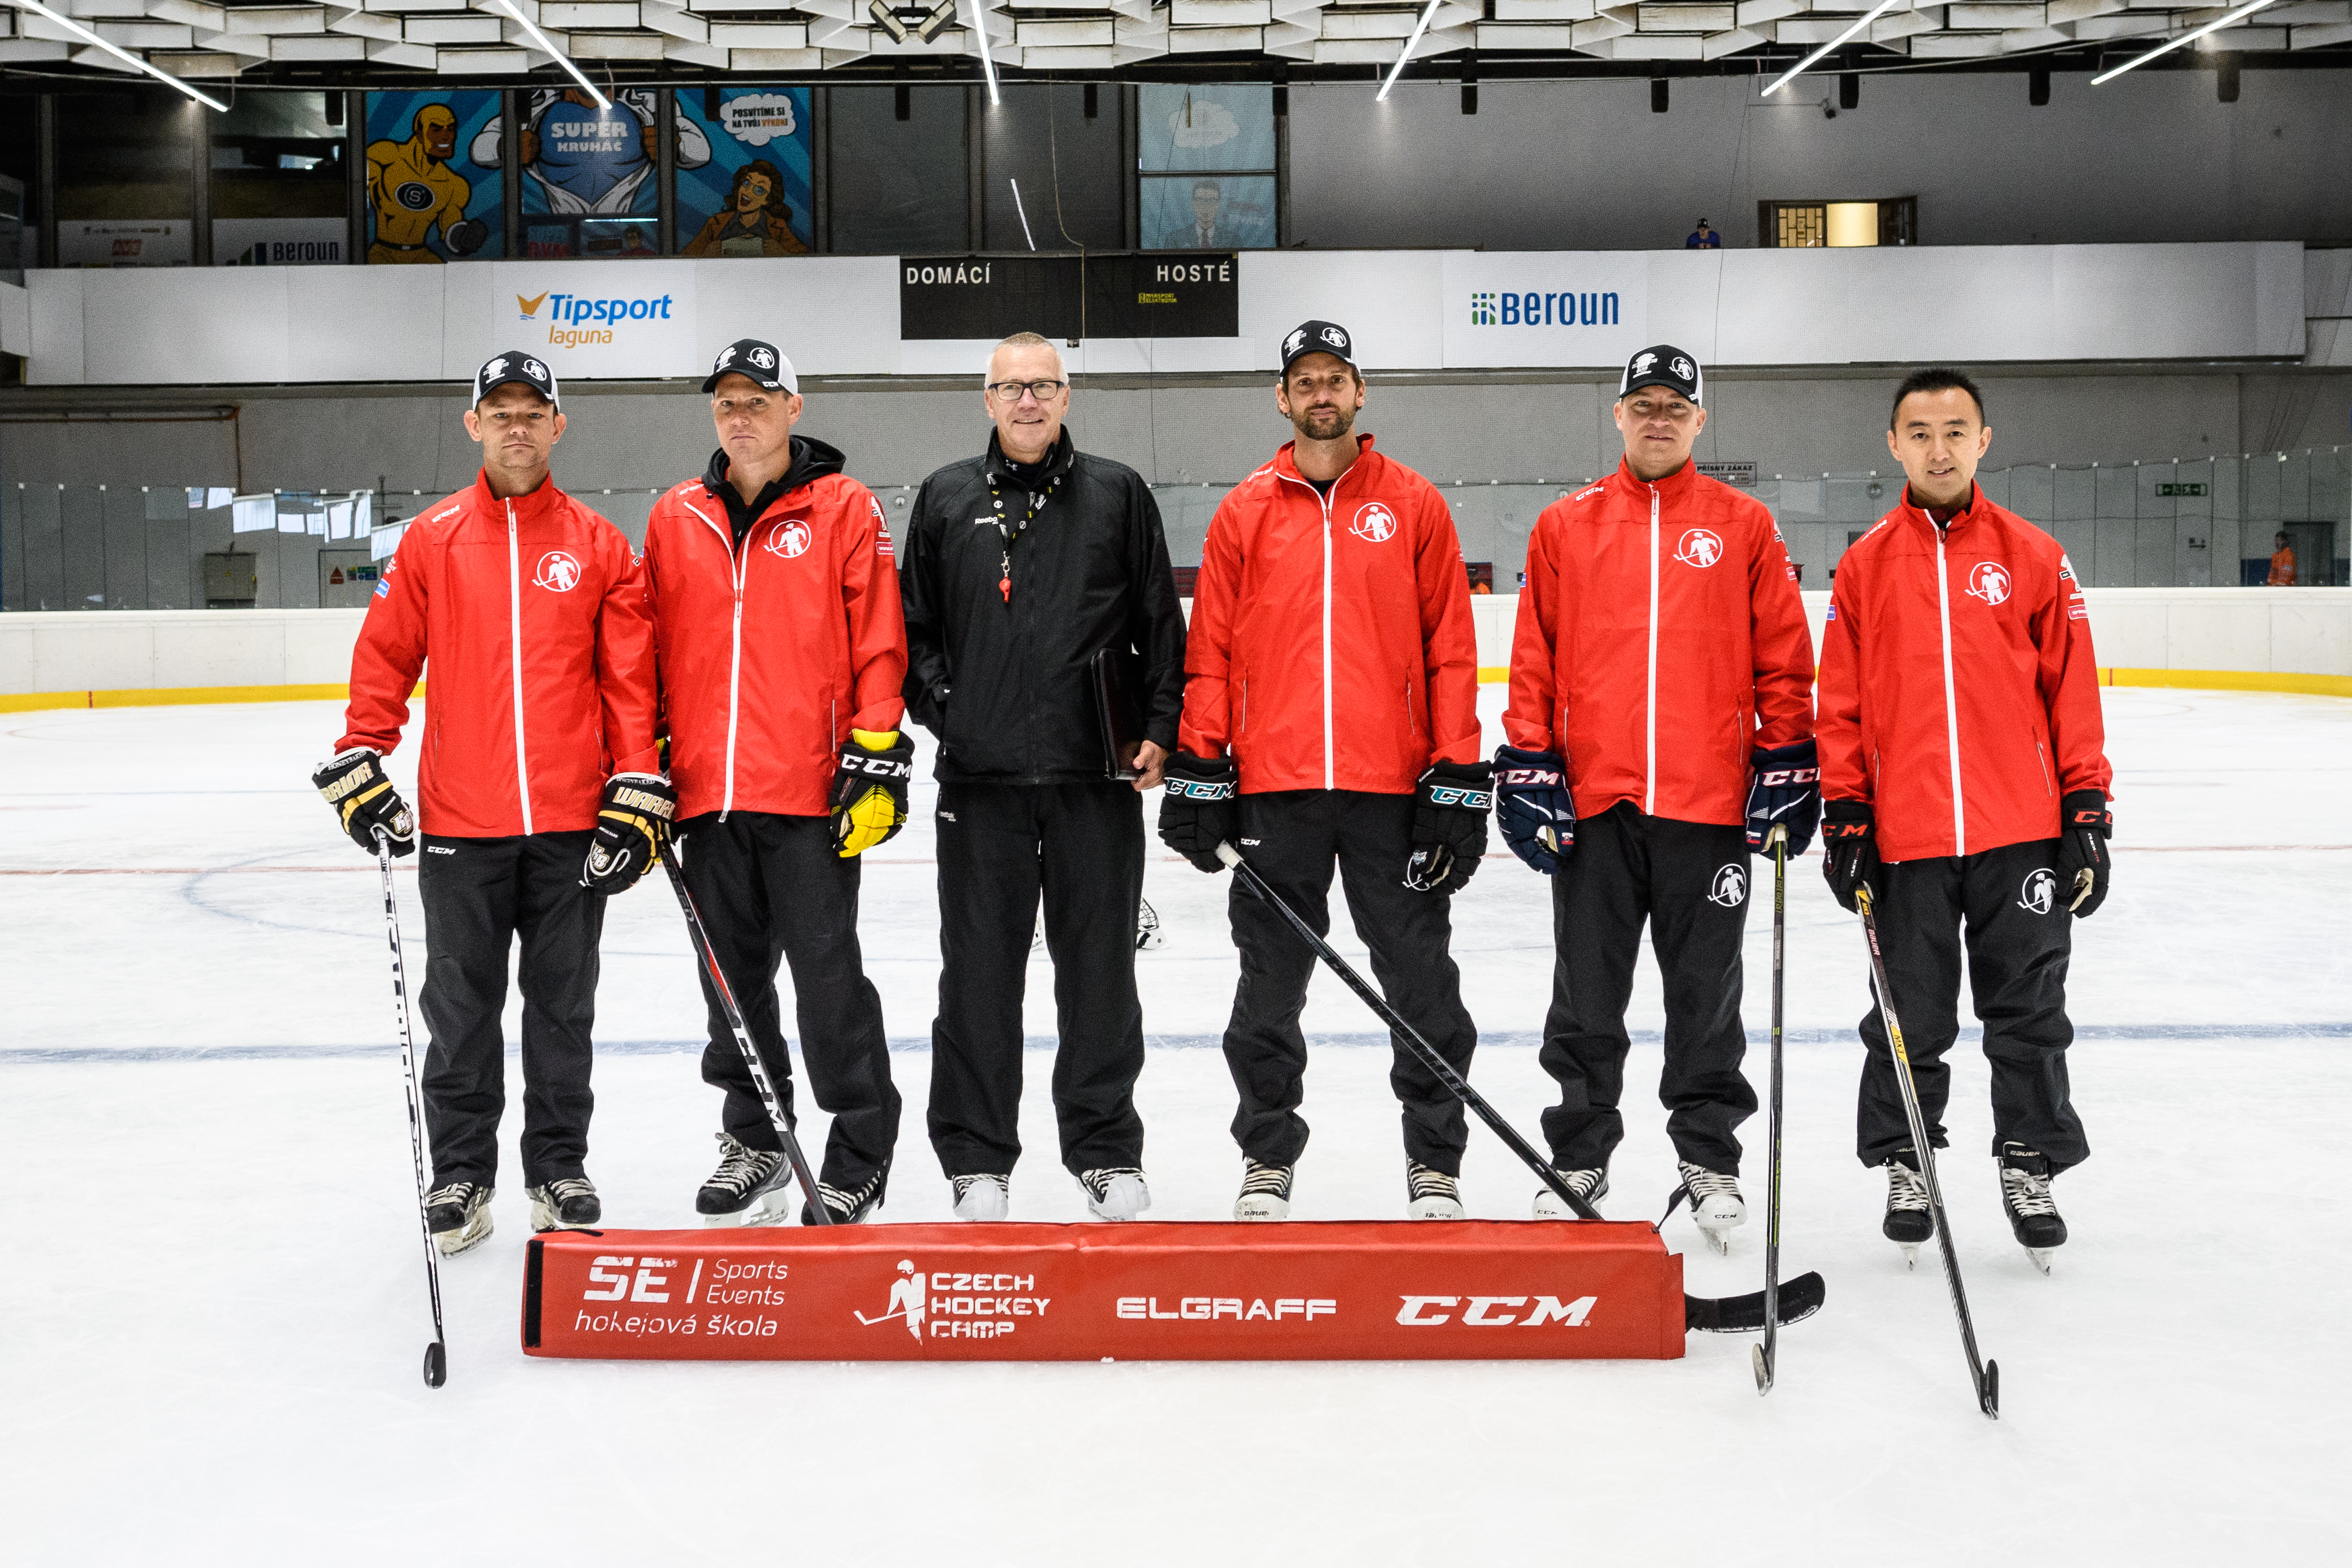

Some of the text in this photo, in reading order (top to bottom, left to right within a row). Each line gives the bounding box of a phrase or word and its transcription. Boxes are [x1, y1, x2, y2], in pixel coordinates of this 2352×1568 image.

[551, 122, 628, 138] SUPER
[273, 242, 338, 261] Beroun
[907, 263, 991, 284] DOMÁCÍ
[1157, 261, 1230, 281] HOSTÉ
[549, 294, 672, 326] Tipsport
[1502, 293, 1619, 325] Beroun
[549, 325, 612, 348] laguna
[1575, 487, 1604, 501] CCM
[841, 753, 912, 778] CCM
[1762, 767, 1821, 787] CC
[1164, 777, 1238, 800] CCM
[1430, 785, 1493, 809] CC
[1823, 824, 1868, 837] CM
[427, 846, 456, 855] CCM
[1893, 1034, 1905, 1054] MX3
[733, 1024, 788, 1132] CCM
[713, 1258, 789, 1283] Sports
[931, 1272, 1034, 1291] CZECH
[706, 1284, 785, 1306] Events
[930, 1297, 1051, 1316] HOCKEY
[1117, 1297, 1337, 1321] ELGRAFF
[574, 1309, 778, 1338] hokejová škola
[930, 1320, 1015, 1338] CAMP
